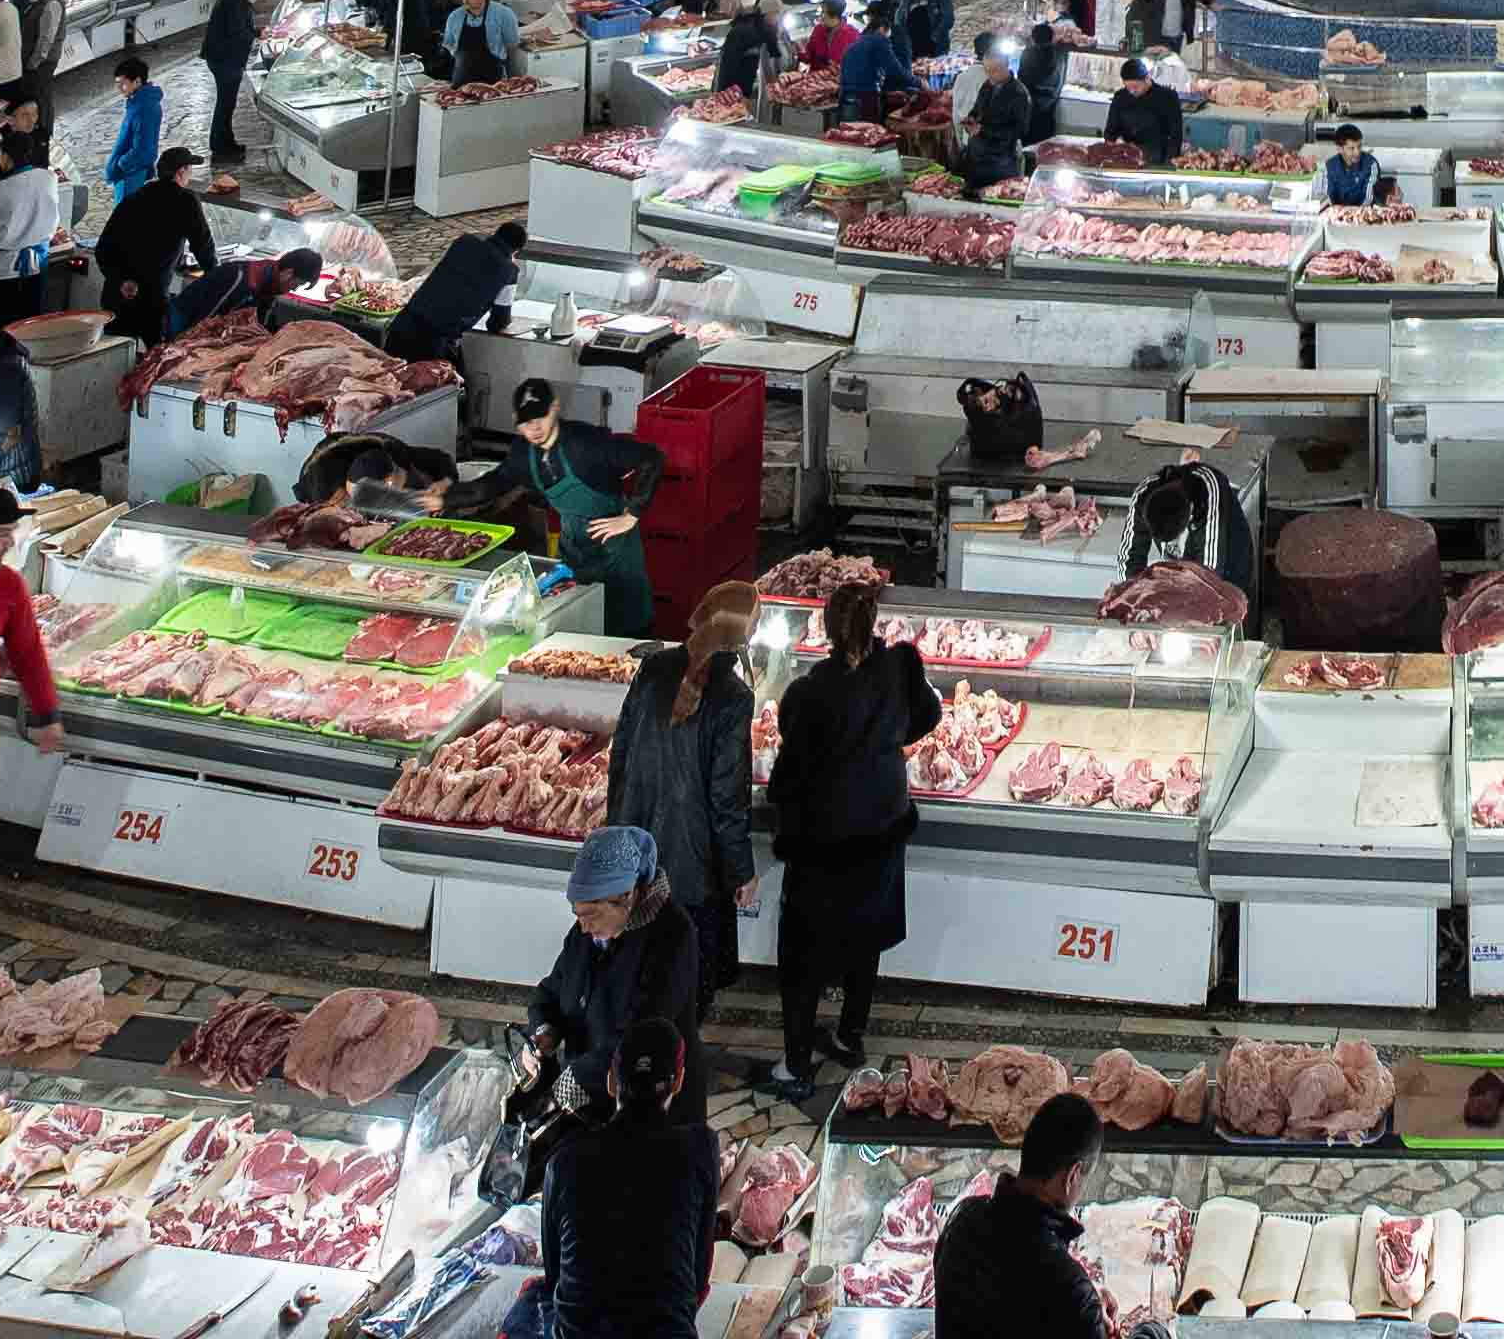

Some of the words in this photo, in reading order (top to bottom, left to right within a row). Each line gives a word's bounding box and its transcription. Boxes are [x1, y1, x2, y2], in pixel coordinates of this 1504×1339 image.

[793, 292, 818, 311] 275
[114, 810, 164, 844] 254
[307, 844, 358, 881] 253
[1058, 923, 1114, 962] 251
